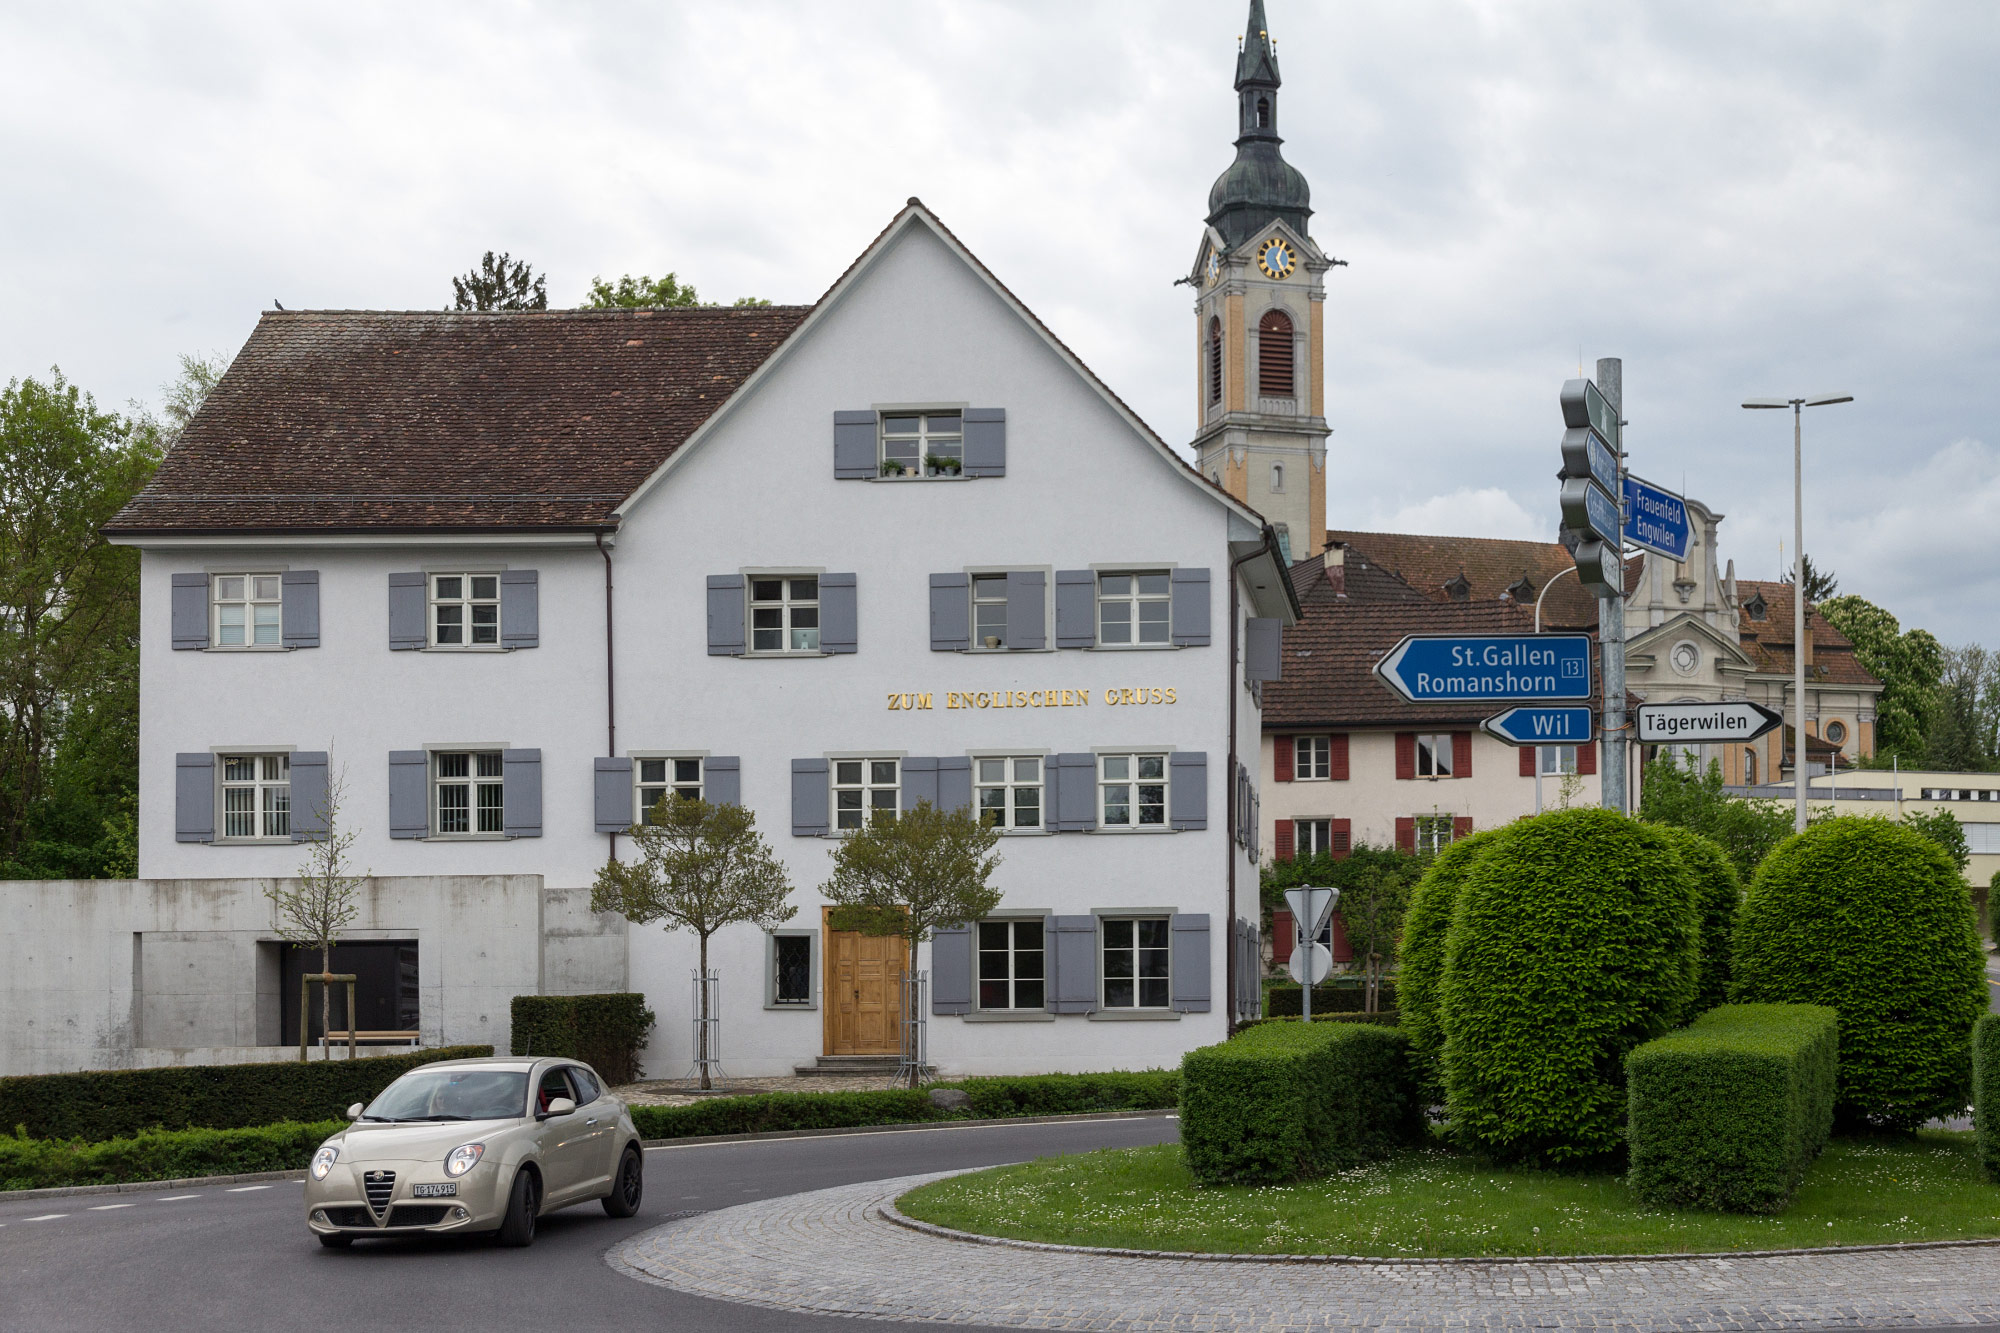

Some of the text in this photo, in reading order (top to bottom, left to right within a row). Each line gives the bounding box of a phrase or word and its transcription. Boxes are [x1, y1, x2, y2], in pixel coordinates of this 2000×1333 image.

[1637, 489, 1681, 525] Frauenfeld
[1637, 515, 1675, 548] Engwilen
[1565, 661, 1579, 676] 13
[1417, 670, 1556, 693] Romanshorn
[887, 687, 1178, 711] ZUM ENGLISCHEN GRUSS
[1532, 714, 1569, 735] Wil
[1645, 712, 1747, 735] Tägerwilen
